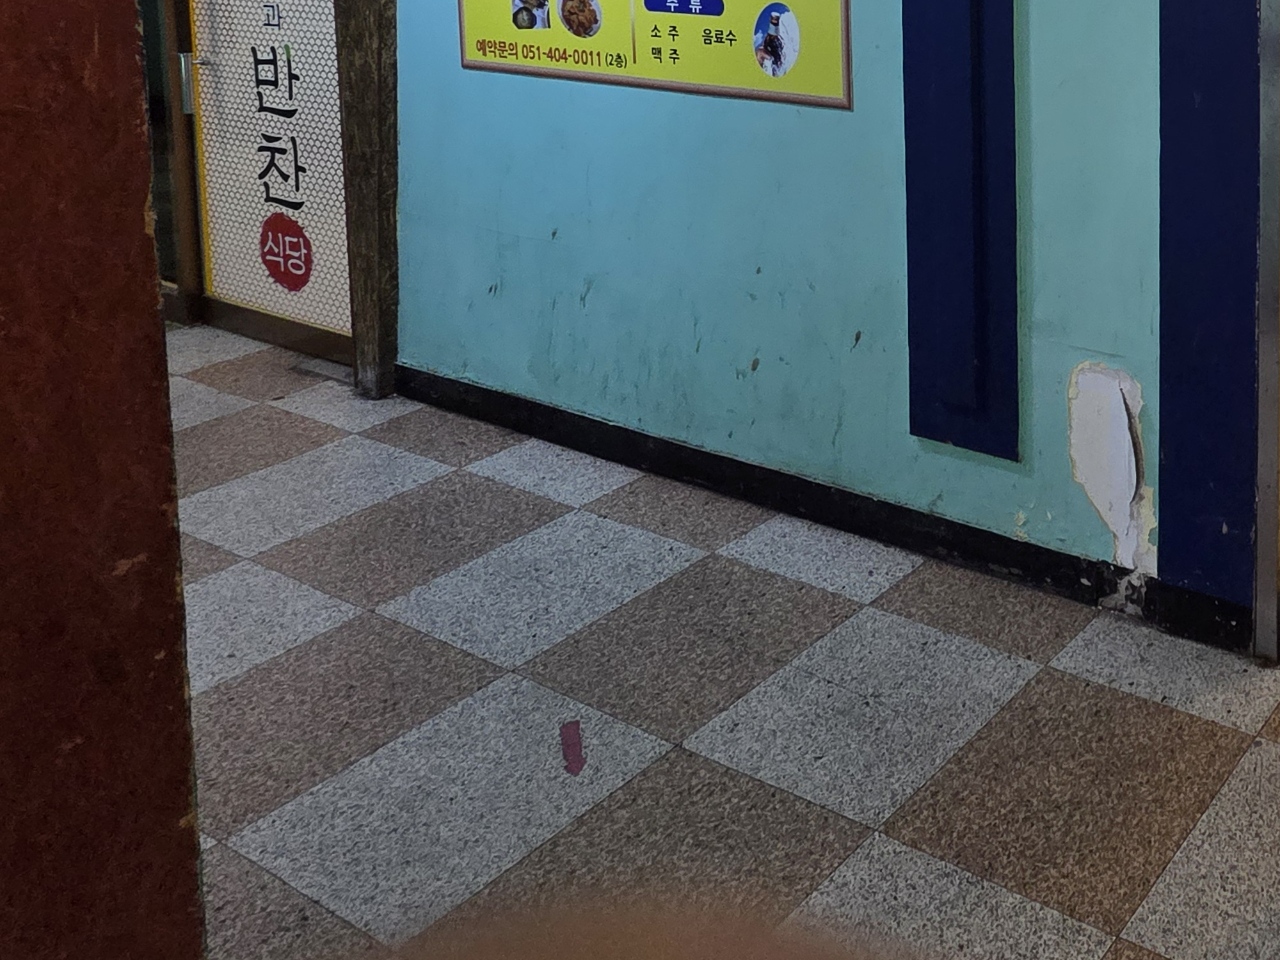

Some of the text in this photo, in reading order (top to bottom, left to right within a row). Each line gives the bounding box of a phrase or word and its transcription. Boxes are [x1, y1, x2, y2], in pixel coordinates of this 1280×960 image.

[701, 28, 738, 47] 음료수
[476, 38, 628, 69] 예약문의 051-404-0011 (2층)
[263, 231, 308, 275] 식당
